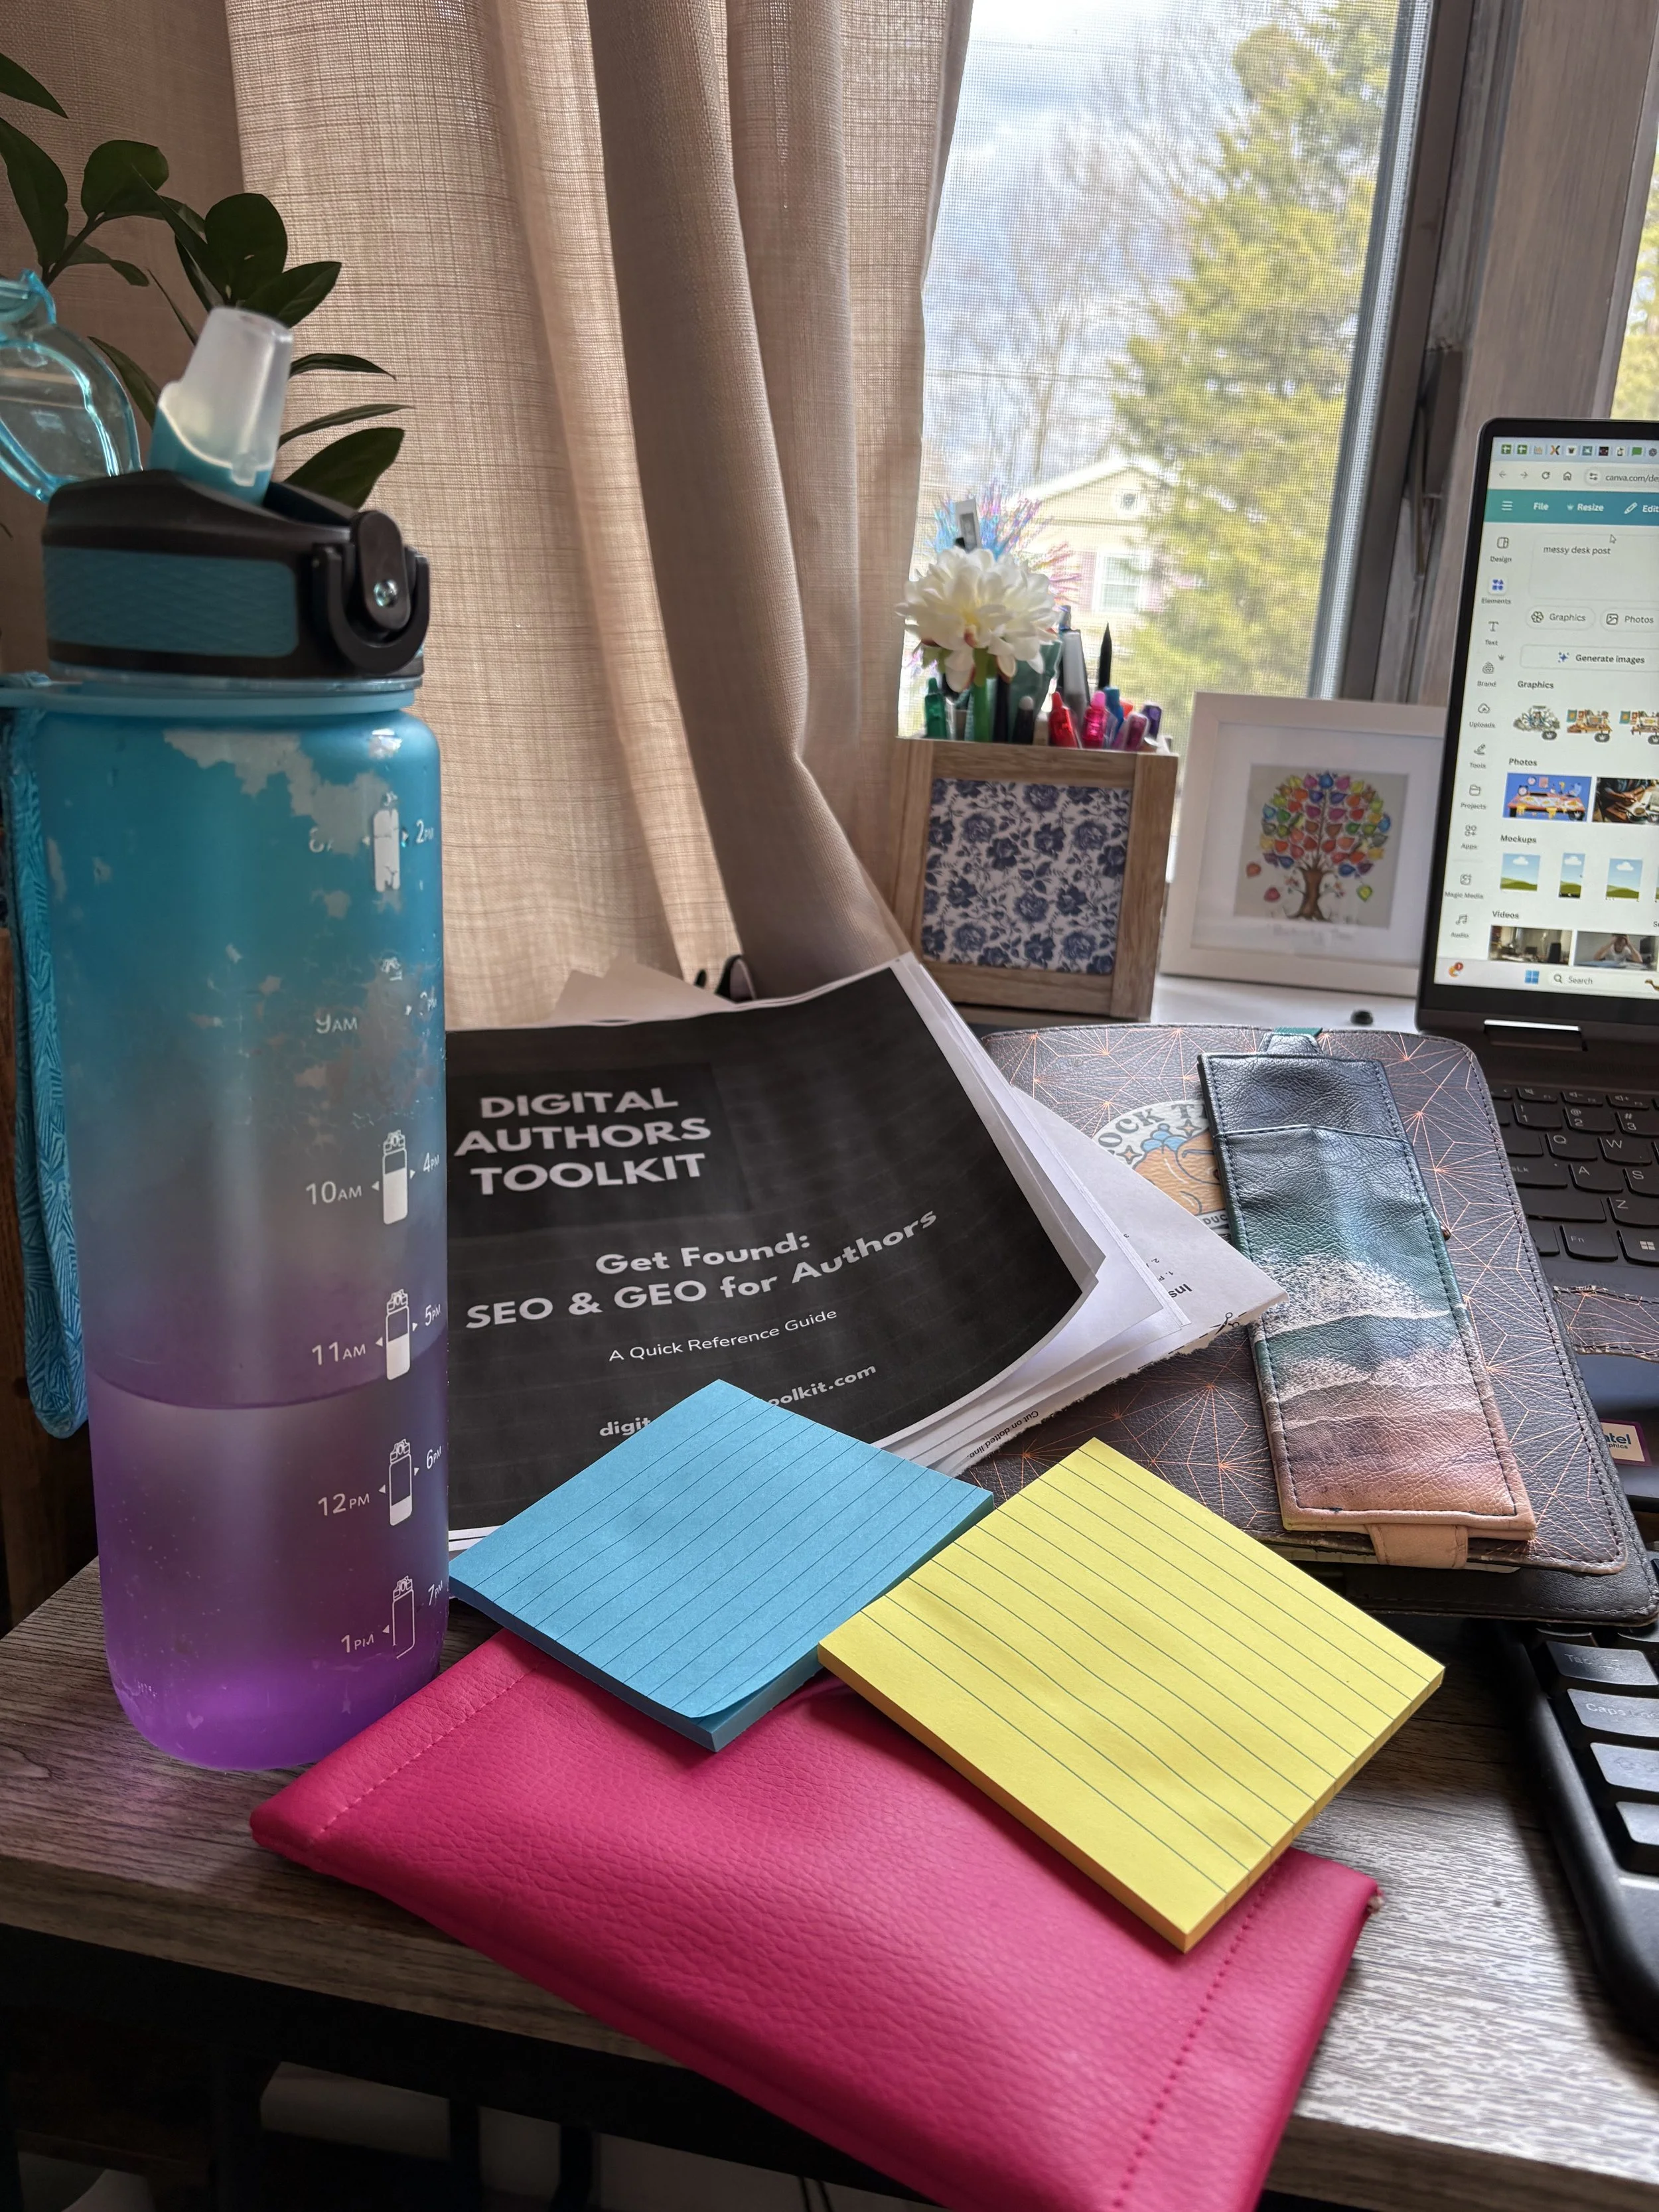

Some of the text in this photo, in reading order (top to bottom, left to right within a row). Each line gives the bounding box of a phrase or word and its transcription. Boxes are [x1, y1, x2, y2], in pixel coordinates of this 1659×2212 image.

[1533, 502, 1549, 511] File
[1577, 504, 1605, 512] Resize
[1543, 546, 1611, 555] messy desk post
[1549, 613, 1586, 623] Graphics
[1624, 615, 1654, 624] Photos
[1575, 654, 1645, 665] Generate images
[1517, 680, 1554, 690] Graphics
[1508, 757, 1538, 767] Photos
[1460, 802, 1487, 810] Projects
[1500, 834, 1537, 844] Mockups
[1461, 842, 1478, 851] Apps
[1444, 891, 1463, 899] Magic
[1492, 910, 1520, 920] Videos
[1567, 975, 1593, 985] Search
[480, 1087, 678, 1118] DIGITAL
[1098, 1108, 1165, 1155] OCK
[1627, 1122, 1637, 1131] 3
[454, 1118, 712, 1156] AUTHORS
[1553, 1134, 1567, 1145] Q
[1606, 1138, 1623, 1149] W
[423, 1152, 440, 1173] 4PM
[470, 1153, 705, 1195] TOOLKIT
[1578, 1165, 1591, 1176] A
[1632, 1170, 1644, 1180] S
[306, 1181, 362, 1206] 10AM
[1615, 1199, 1628, 1209] Z
[595, 1232, 811, 1274] Get Found:
[465, 1211, 936, 1329] SEO & GEO for Authors
[1168, 1284, 1193, 1298] Ins
[425, 1303, 441, 1327] 5PM
[609, 1309, 837, 1362] A Quick Reference Guide
[312, 1341, 366, 1366] 11AM
[966, 1410, 1039, 1459] Cut on dotted line.
[426, 1445, 442, 1469] 6PM
[318, 1493, 370, 1516] 12PM
[1585, 1702, 1626, 1716] Caps
